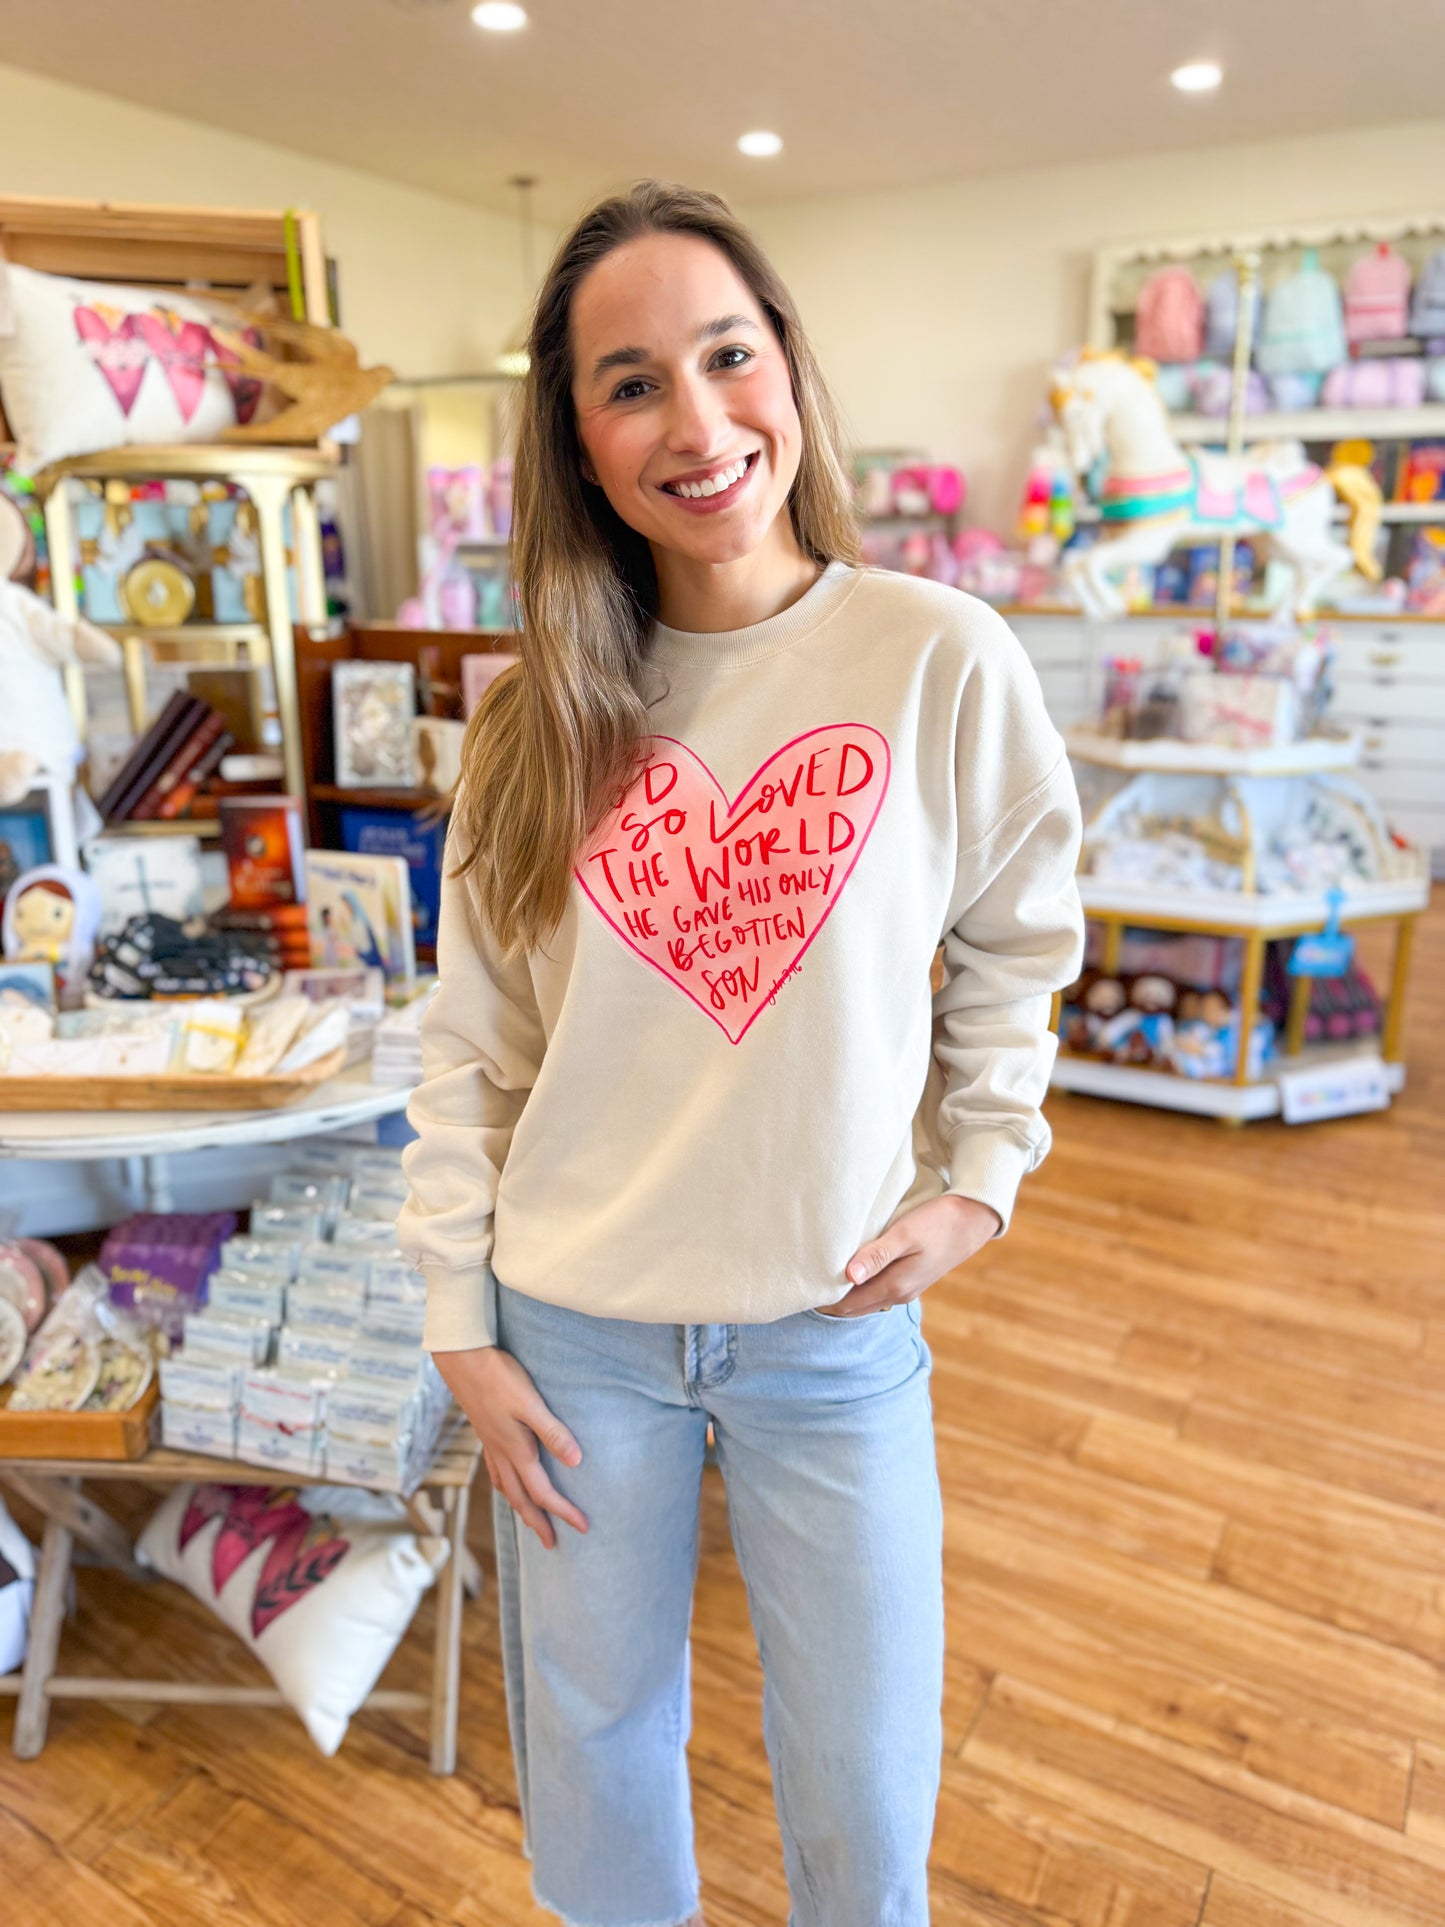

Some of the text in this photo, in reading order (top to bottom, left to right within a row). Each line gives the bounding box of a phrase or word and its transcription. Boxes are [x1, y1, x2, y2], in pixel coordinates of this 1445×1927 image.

[588, 811, 856, 903] THE WORLD
[623, 863, 834, 940] HE GAVE HIS ONLY
[667, 906, 806, 971] BEGOTTEN
[701, 955, 760, 1010] SON
